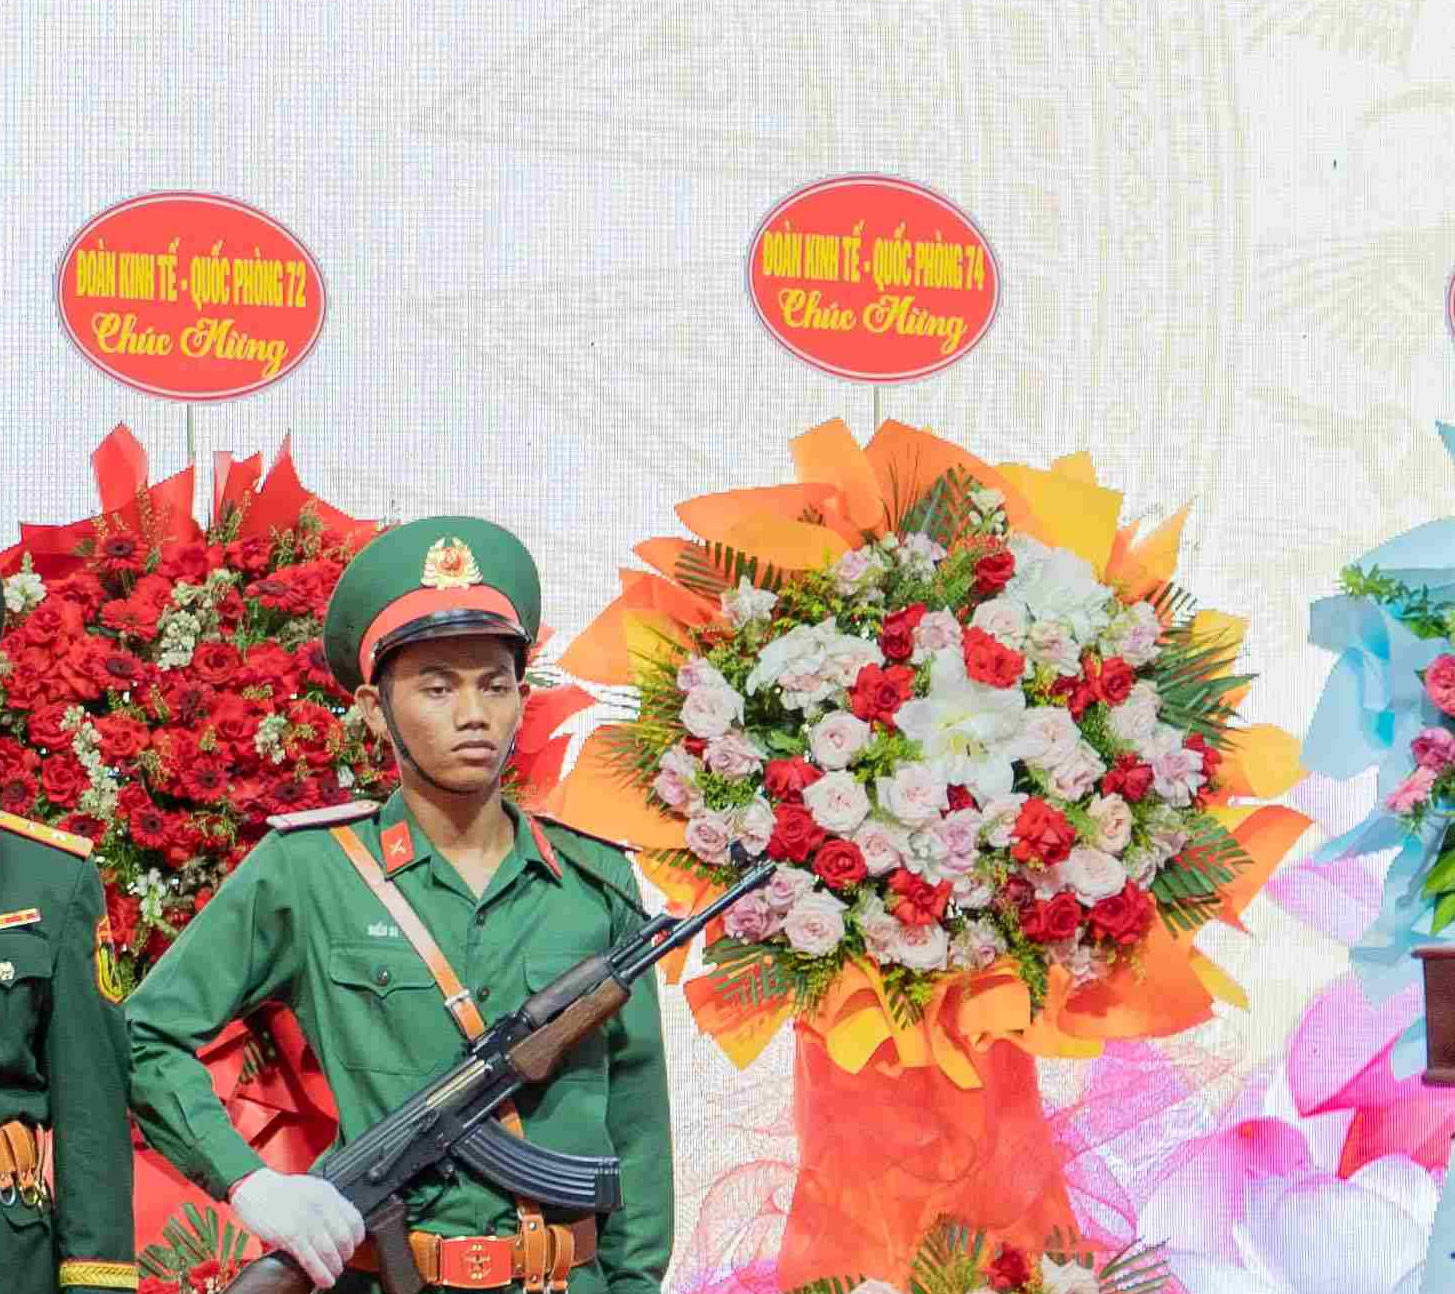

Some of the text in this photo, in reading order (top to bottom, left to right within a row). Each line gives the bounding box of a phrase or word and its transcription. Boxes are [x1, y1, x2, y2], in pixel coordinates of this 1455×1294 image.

[75, 238, 116, 298] ĐOÀN
[119, 251, 155, 301] KINH
[157, 236, 181, 303] TẾ
[191, 238, 231, 312] QUỐC
[234, 245, 284, 308] PHÒNG
[287, 259, 308, 308] 72
[762, 218, 803, 278] ĐOÀN
[804, 233, 840, 283] KINH
[842, 218, 866, 284] TẾ
[873, 220, 912, 293] QUỐC
[914, 230, 964, 291] PHÒNG
[966, 245, 985, 292] 74
[91, 311, 289, 379] Chúc Mừng
[778, 288, 968, 356] Chúc Mừng
